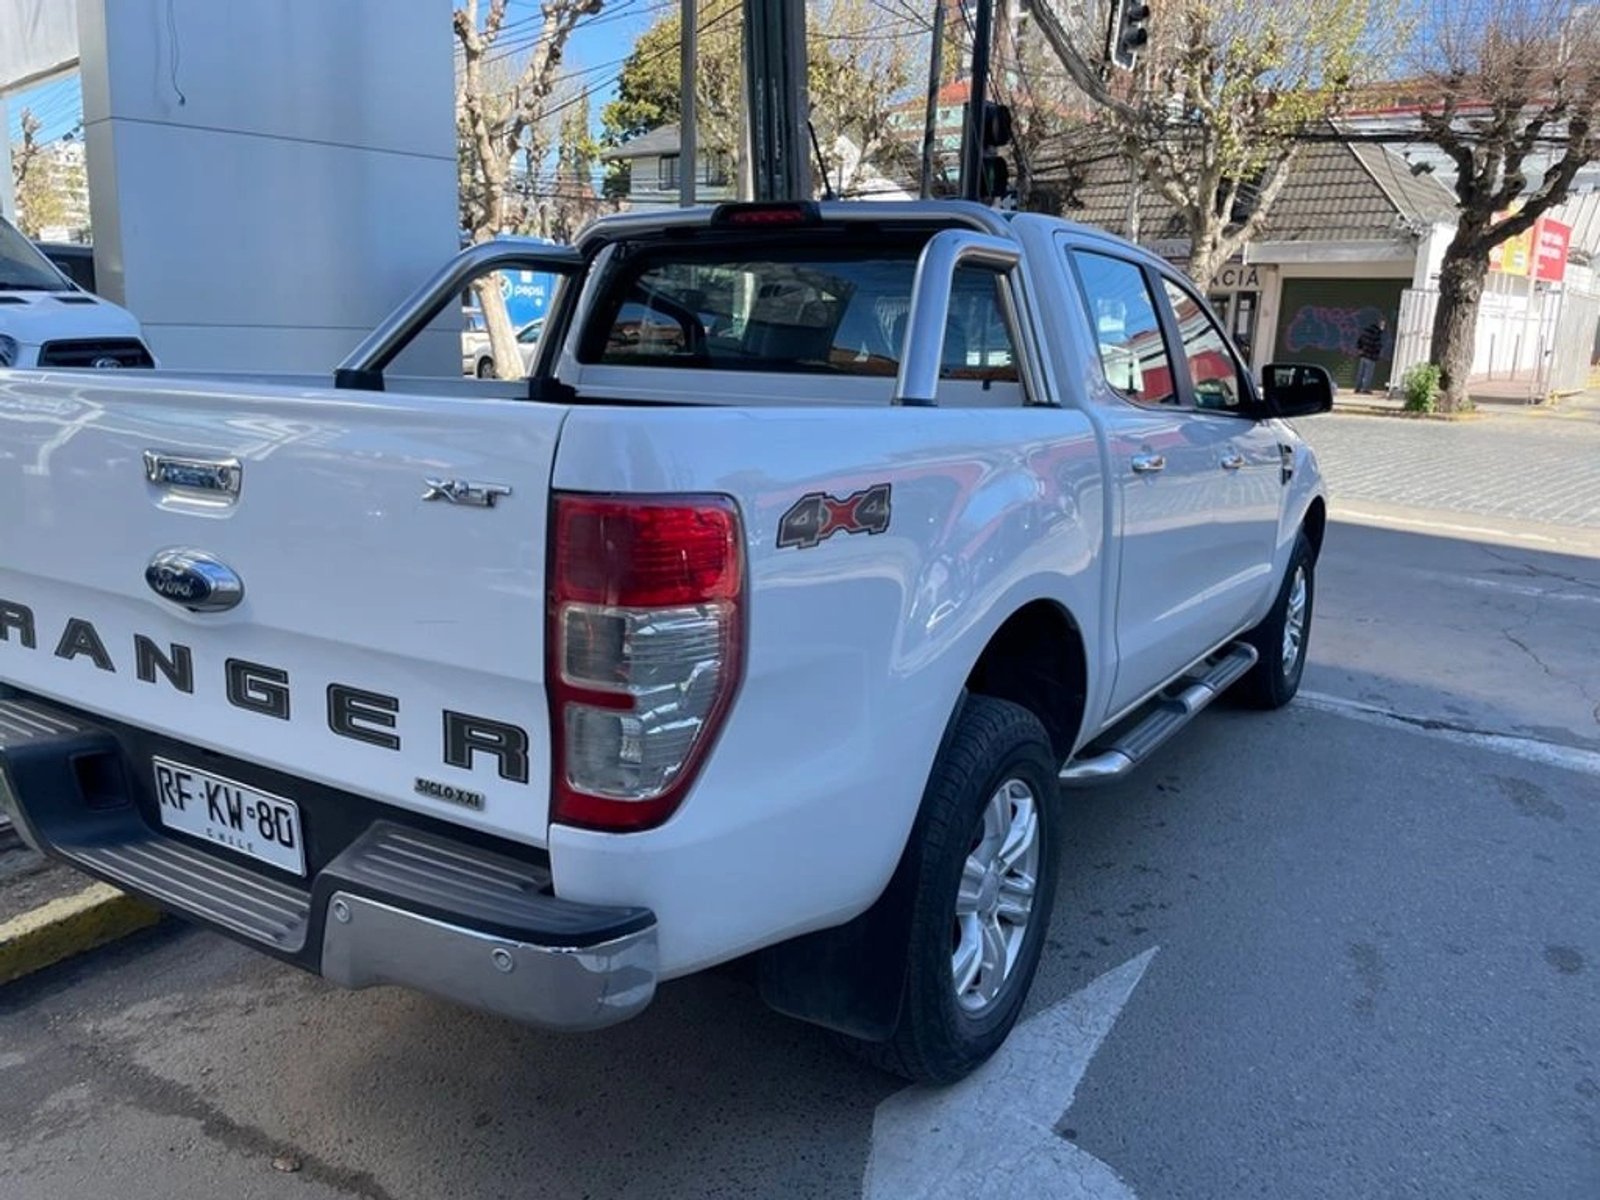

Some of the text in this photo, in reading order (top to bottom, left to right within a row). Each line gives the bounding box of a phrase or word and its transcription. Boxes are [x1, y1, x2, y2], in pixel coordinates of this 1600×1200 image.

[514, 284, 545, 298] pepsi
[421, 478, 512, 507] XLT
[0, 599, 530, 784] RANGER
[206, 828, 254, 851] CHILE
